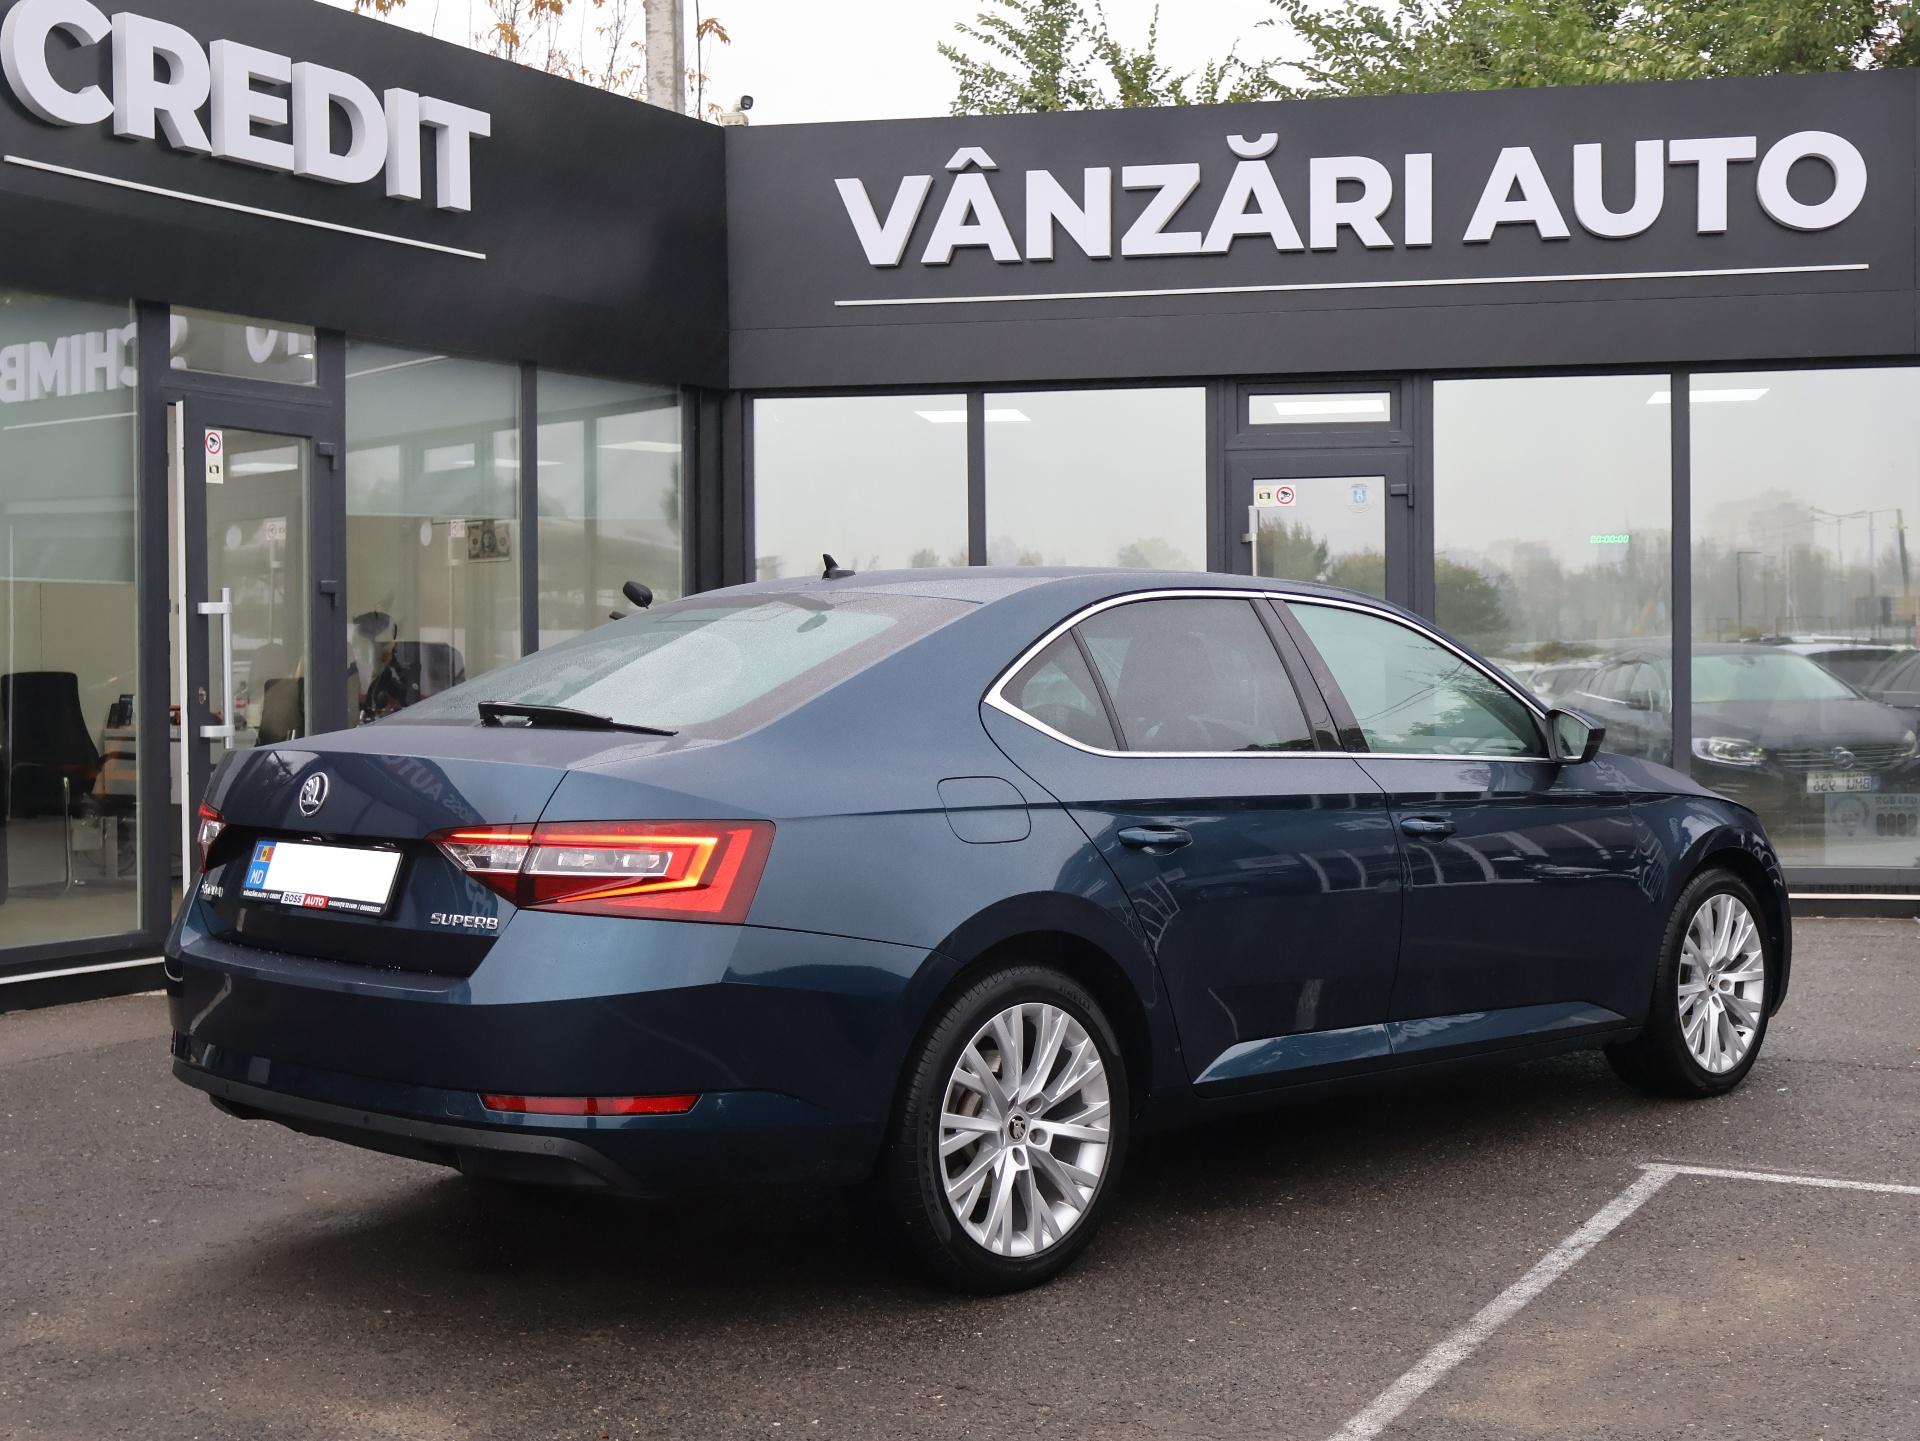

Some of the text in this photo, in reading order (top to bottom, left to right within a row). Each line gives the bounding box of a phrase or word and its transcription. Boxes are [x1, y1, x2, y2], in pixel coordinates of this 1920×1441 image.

[0, 0, 491, 213] CREDIT
[834, 130, 1868, 267] VÂNZĂRI AUTO
[250, 869, 264, 885] MD
[283, 893, 302, 904] BOSS
[305, 896, 325, 907] AUTO
[430, 912, 499, 930] SUPERB
